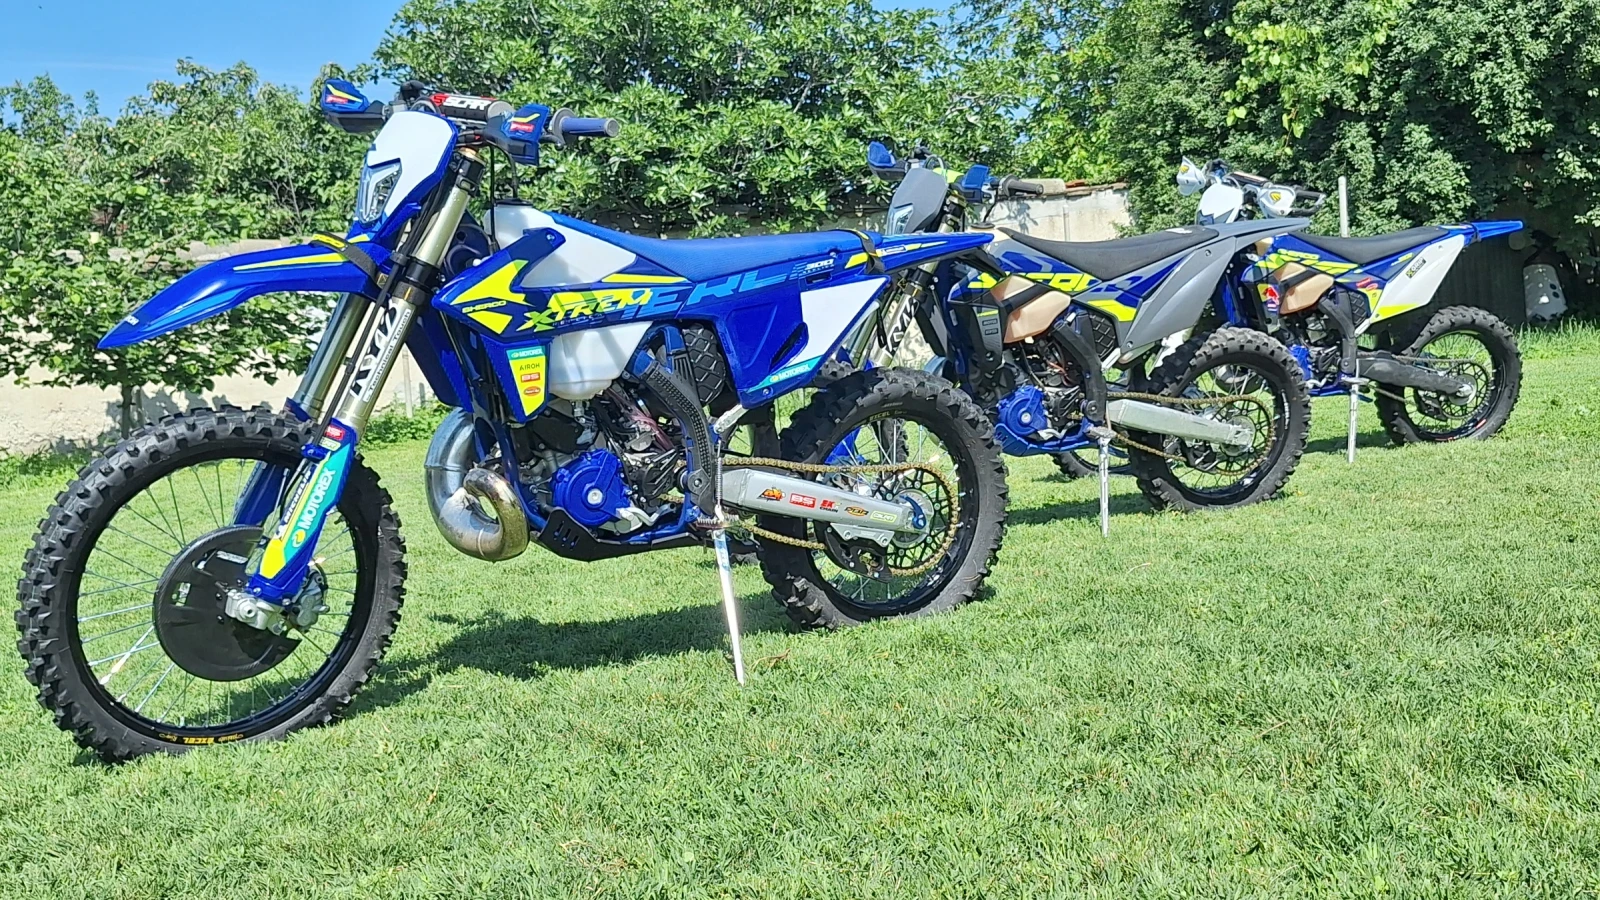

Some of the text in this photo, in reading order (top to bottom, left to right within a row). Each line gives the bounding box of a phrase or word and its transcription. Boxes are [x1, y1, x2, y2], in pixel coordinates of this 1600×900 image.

[462, 301, 507, 314] SHERCO
[369, 345, 394, 391] Technical
[394, 311, 410, 340] Touch
[519, 348, 543, 358] MOTOREX
[519, 363, 540, 371] AIROH
[779, 363, 811, 380] MOTOREX
[283, 469, 312, 523] MICHELIN
[297, 467, 336, 530] MOTOREX
